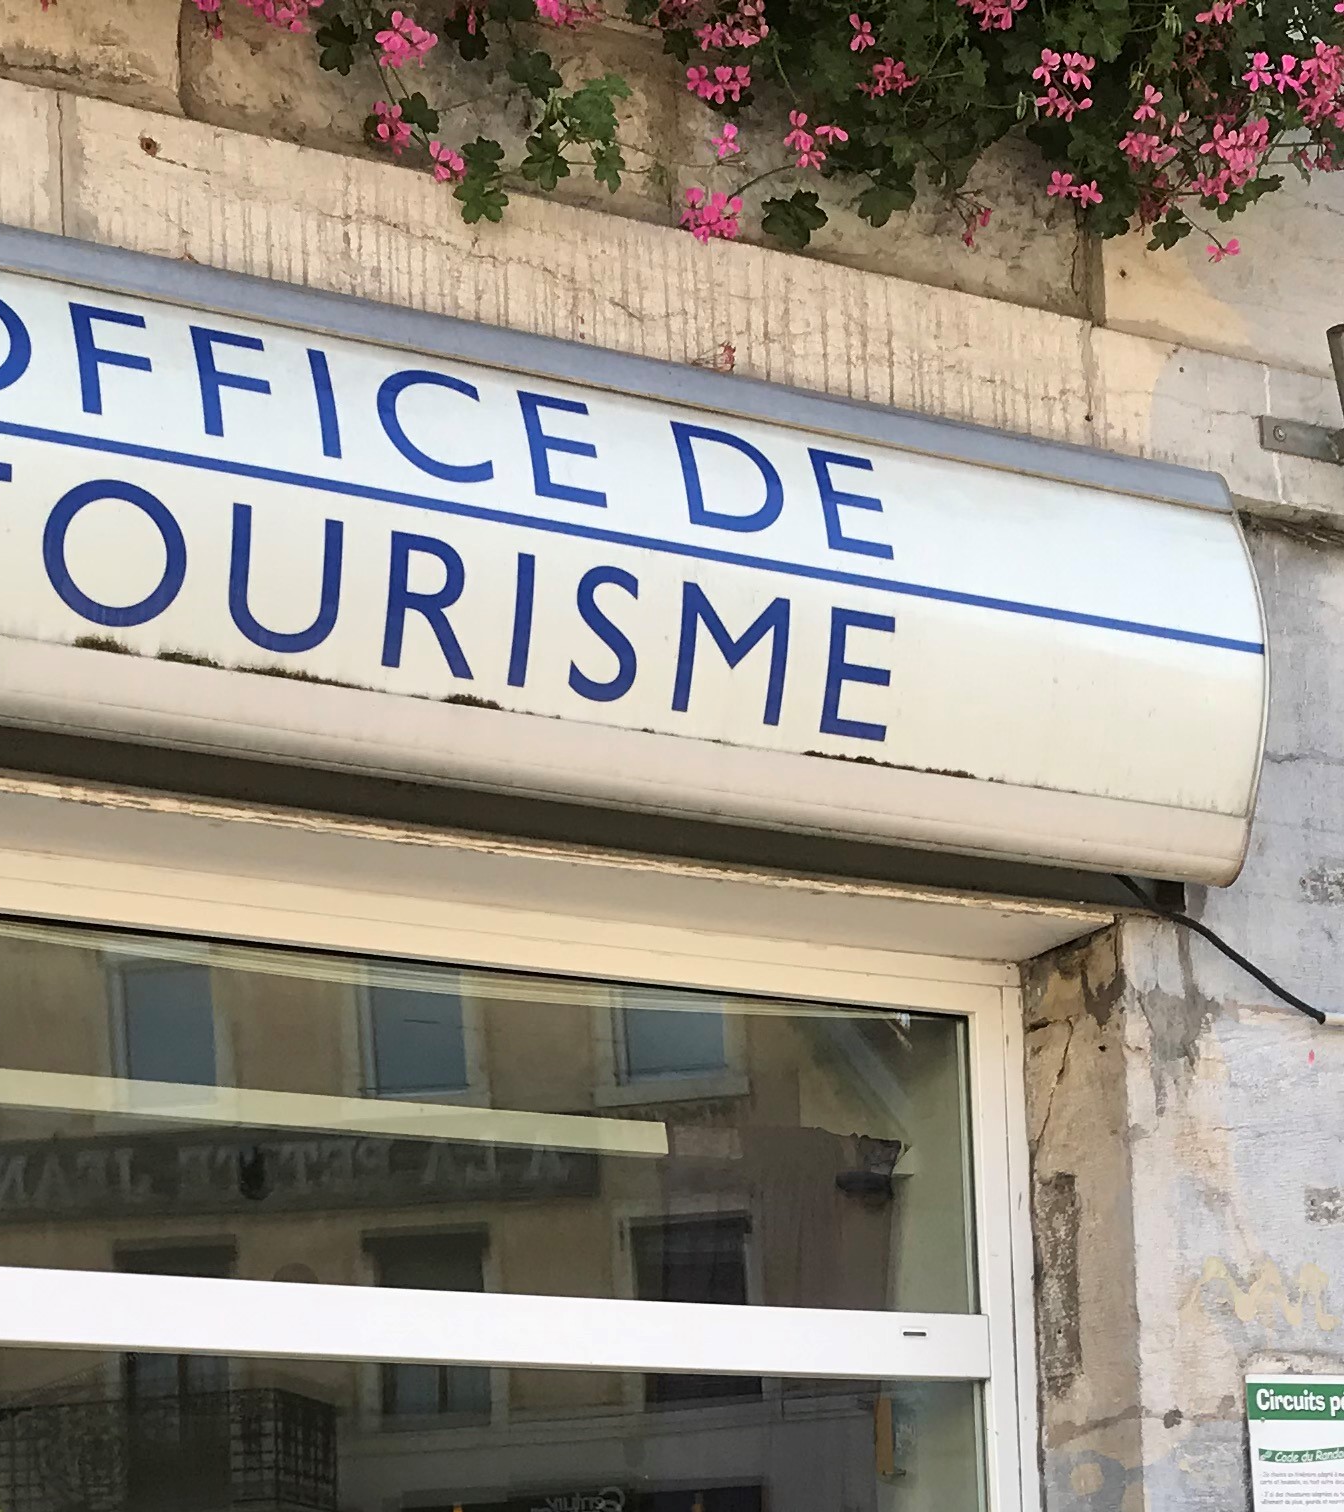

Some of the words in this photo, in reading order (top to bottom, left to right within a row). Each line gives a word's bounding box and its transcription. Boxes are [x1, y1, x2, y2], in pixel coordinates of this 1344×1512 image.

[669, 419, 894, 561] DE
[1256, 1388, 1326, 1412] Circuits
[1274, 1451, 1299, 1463] Code
[1301, 1452, 1314, 1463] du
